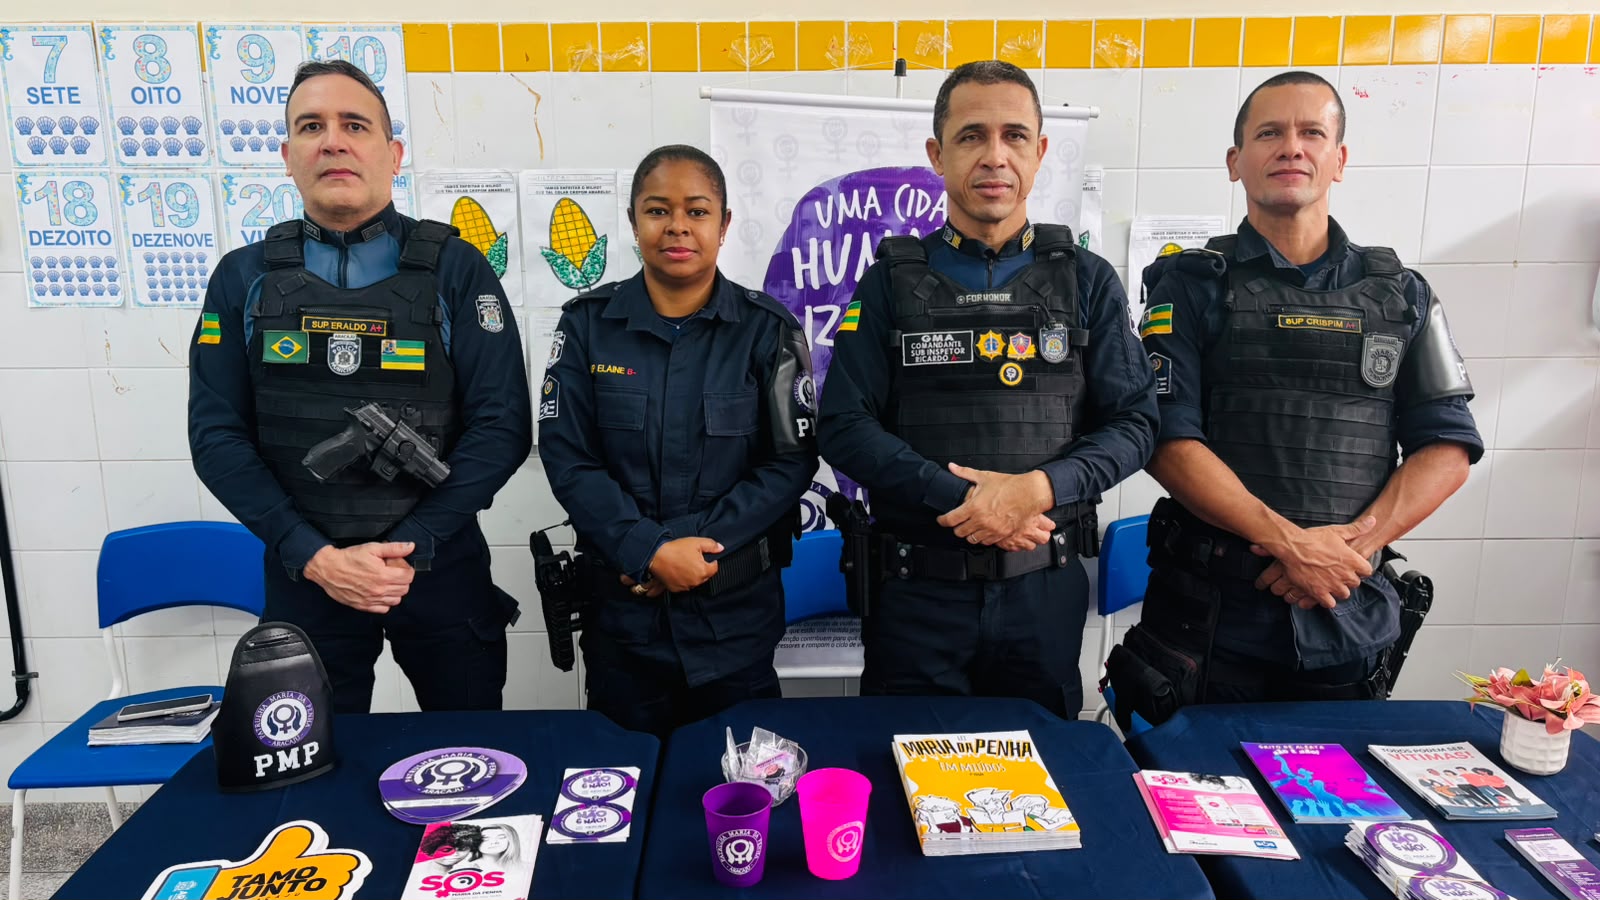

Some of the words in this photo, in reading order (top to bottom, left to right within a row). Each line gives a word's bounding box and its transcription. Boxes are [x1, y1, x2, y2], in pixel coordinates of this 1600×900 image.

[32, 36, 68, 84] 7
[133, 34, 172, 84] 8
[236, 34, 276, 84] 9
[26, 86, 81, 104] SETE
[130, 86, 182, 105] OITO
[230, 86, 289, 105] NOVE
[34, 180, 98, 226] 18
[138, 182, 200, 228] 19
[240, 184, 305, 228] 20
[814, 186, 882, 228] UMA
[28, 230, 112, 246] DEZOITO
[132, 233, 214, 248] DEZENOVE
[312, 320, 330, 328] SUP
[331, 322, 367, 331] ERALDO
[370, 324, 382, 332] A+
[1306, 318, 1344, 328] CRISPIM
[911, 340, 962, 350] COMANDANTE
[921, 334, 954, 342] GMA
[915, 354, 949, 362] RICARDO
[926, 348, 966, 356] INSPETOR
[598, 364, 626, 374] ELAINE
[269, 692, 294, 703] MARIA
[297, 694, 306, 704] DA
[271, 734, 301, 747] ARACAJU
[901, 738, 957, 758] MARIA
[957, 742, 974, 753] DA
[975, 738, 1032, 758] PENHA
[1388, 750, 1475, 760] VÍTIMAS!
[254, 741, 320, 778] PMP
[938, 762, 958, 772] EM
[959, 760, 1007, 773] MIÚDOS
[582, 774, 611, 783] NÃO
[1152, 774, 1188, 784] SOS
[421, 786, 464, 794] ARACAJU
[577, 808, 607, 818] NÃO
[1384, 830, 1418, 844] NÃO
[232, 866, 318, 888] TAMO
[419, 871, 505, 891] SOS
[1429, 878, 1467, 890] NÃO
[216, 878, 328, 900] JUNTO
